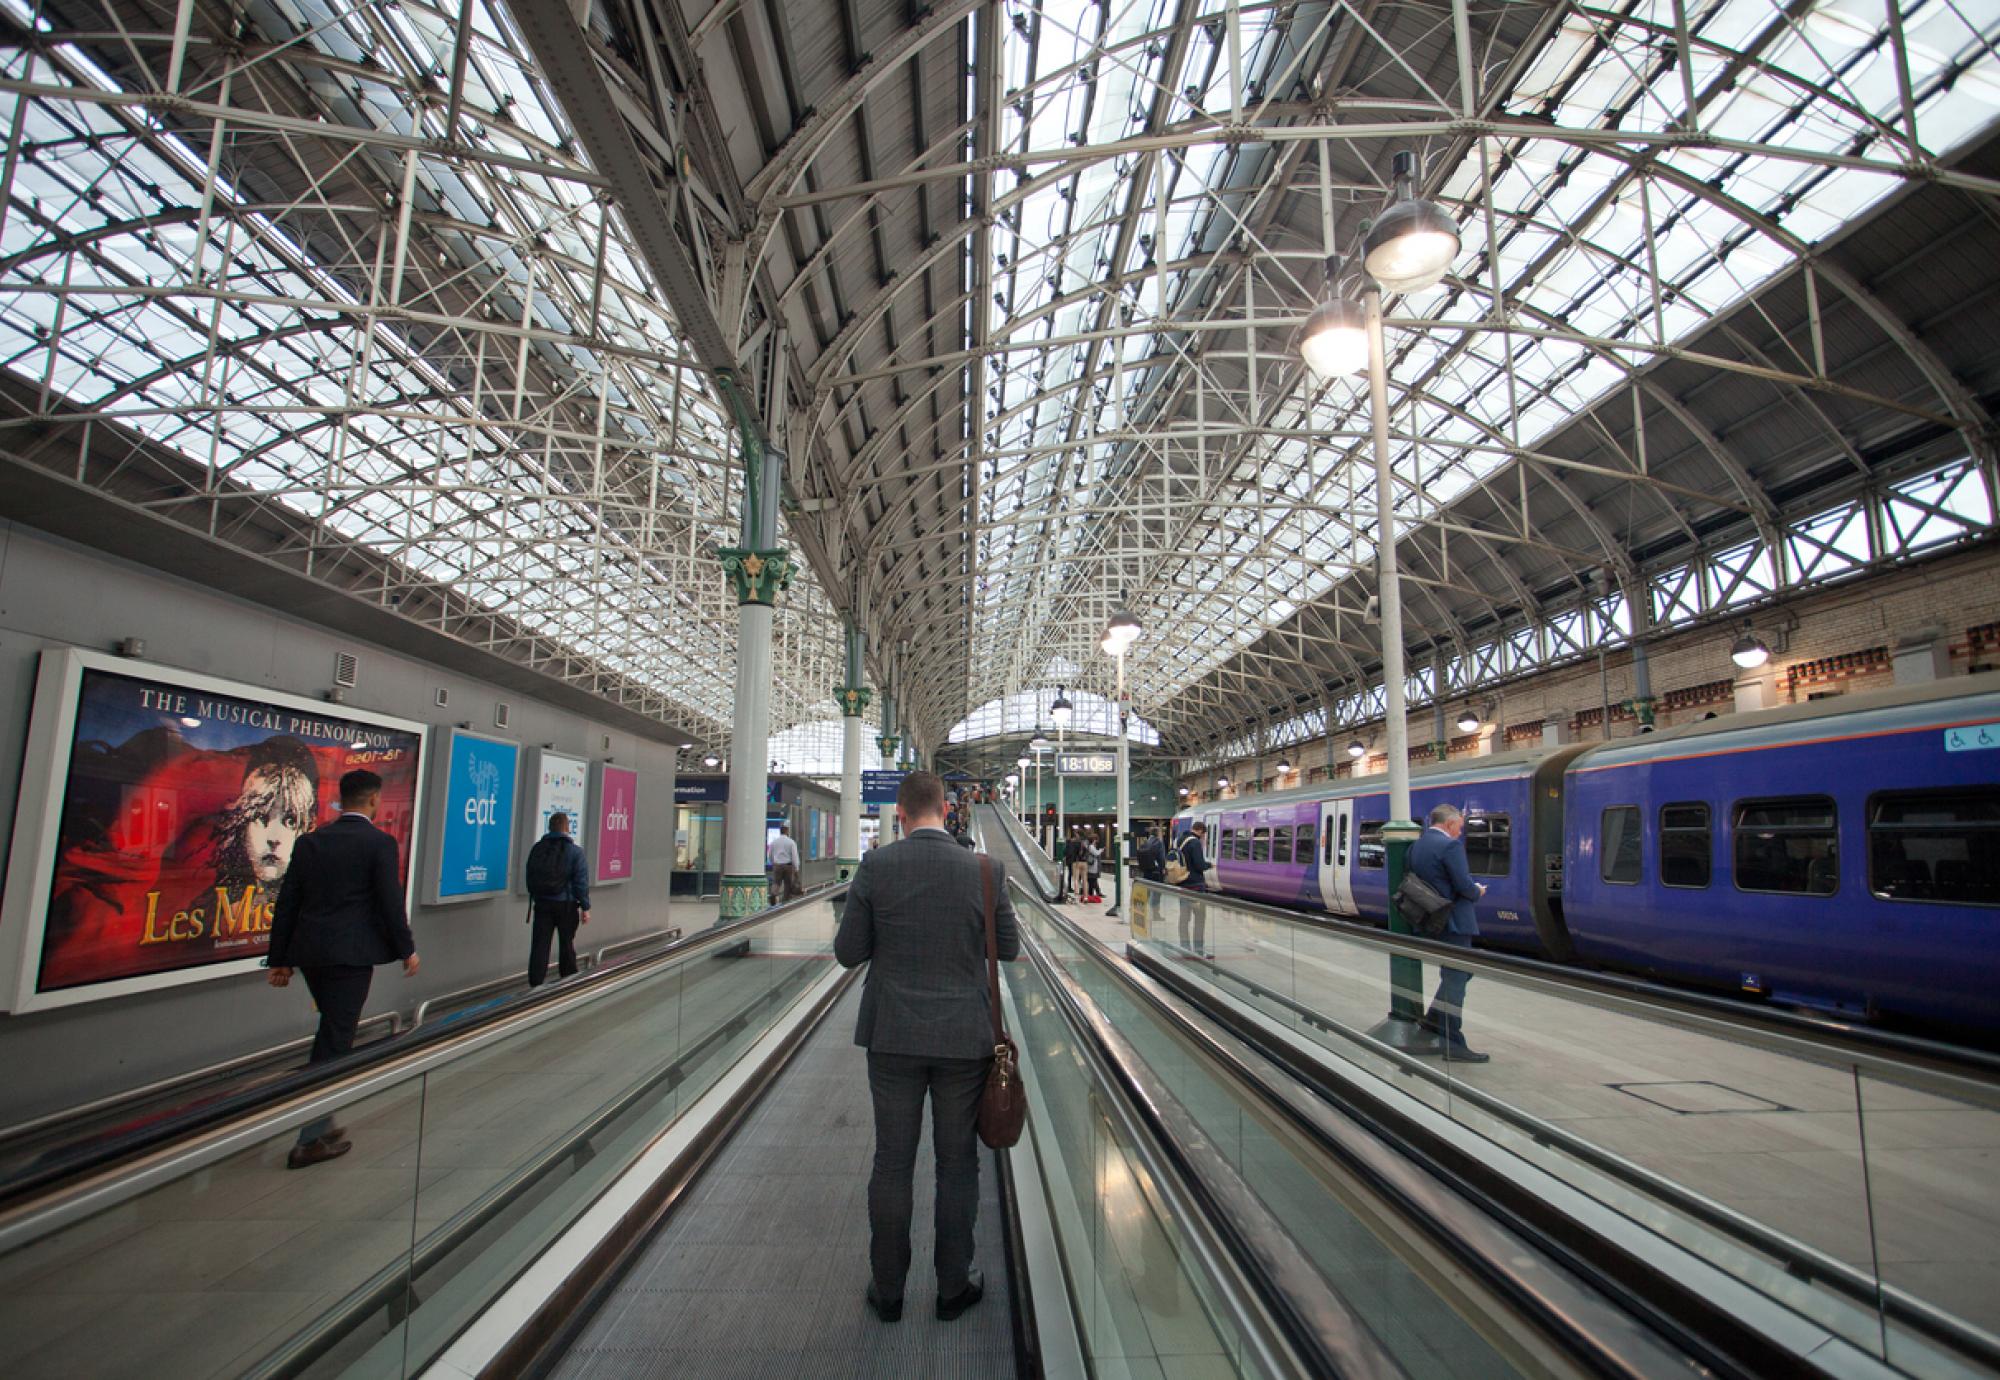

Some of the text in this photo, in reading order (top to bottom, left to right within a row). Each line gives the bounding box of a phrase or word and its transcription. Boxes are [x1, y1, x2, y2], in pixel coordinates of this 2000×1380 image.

[140, 688, 391, 747] THE MUSICAL PHENOMENON
[464, 793, 497, 825] eat
[606, 806, 629, 831] drink
[140, 890, 205, 945] Les
